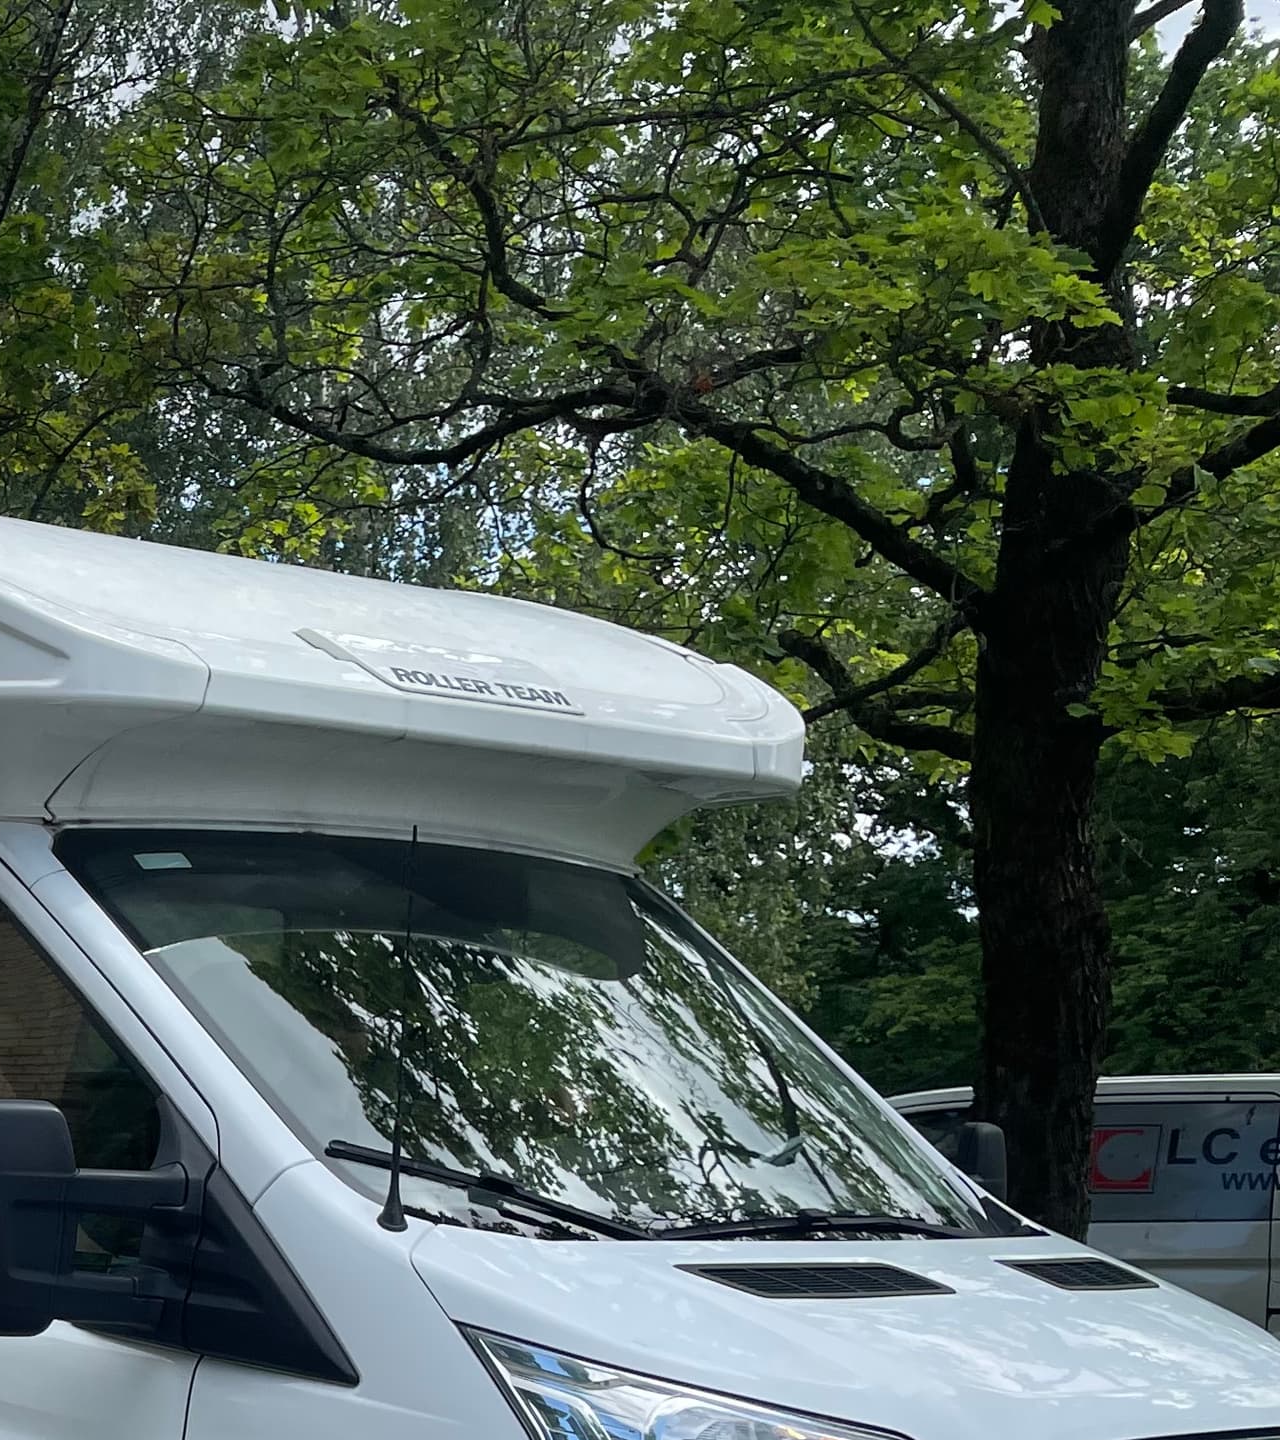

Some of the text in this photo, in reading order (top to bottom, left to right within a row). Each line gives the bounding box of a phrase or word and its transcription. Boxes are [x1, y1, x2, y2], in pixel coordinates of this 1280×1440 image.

[390, 667, 571, 706] ROLLER TEAM
[1168, 1127, 1240, 1165] LC
